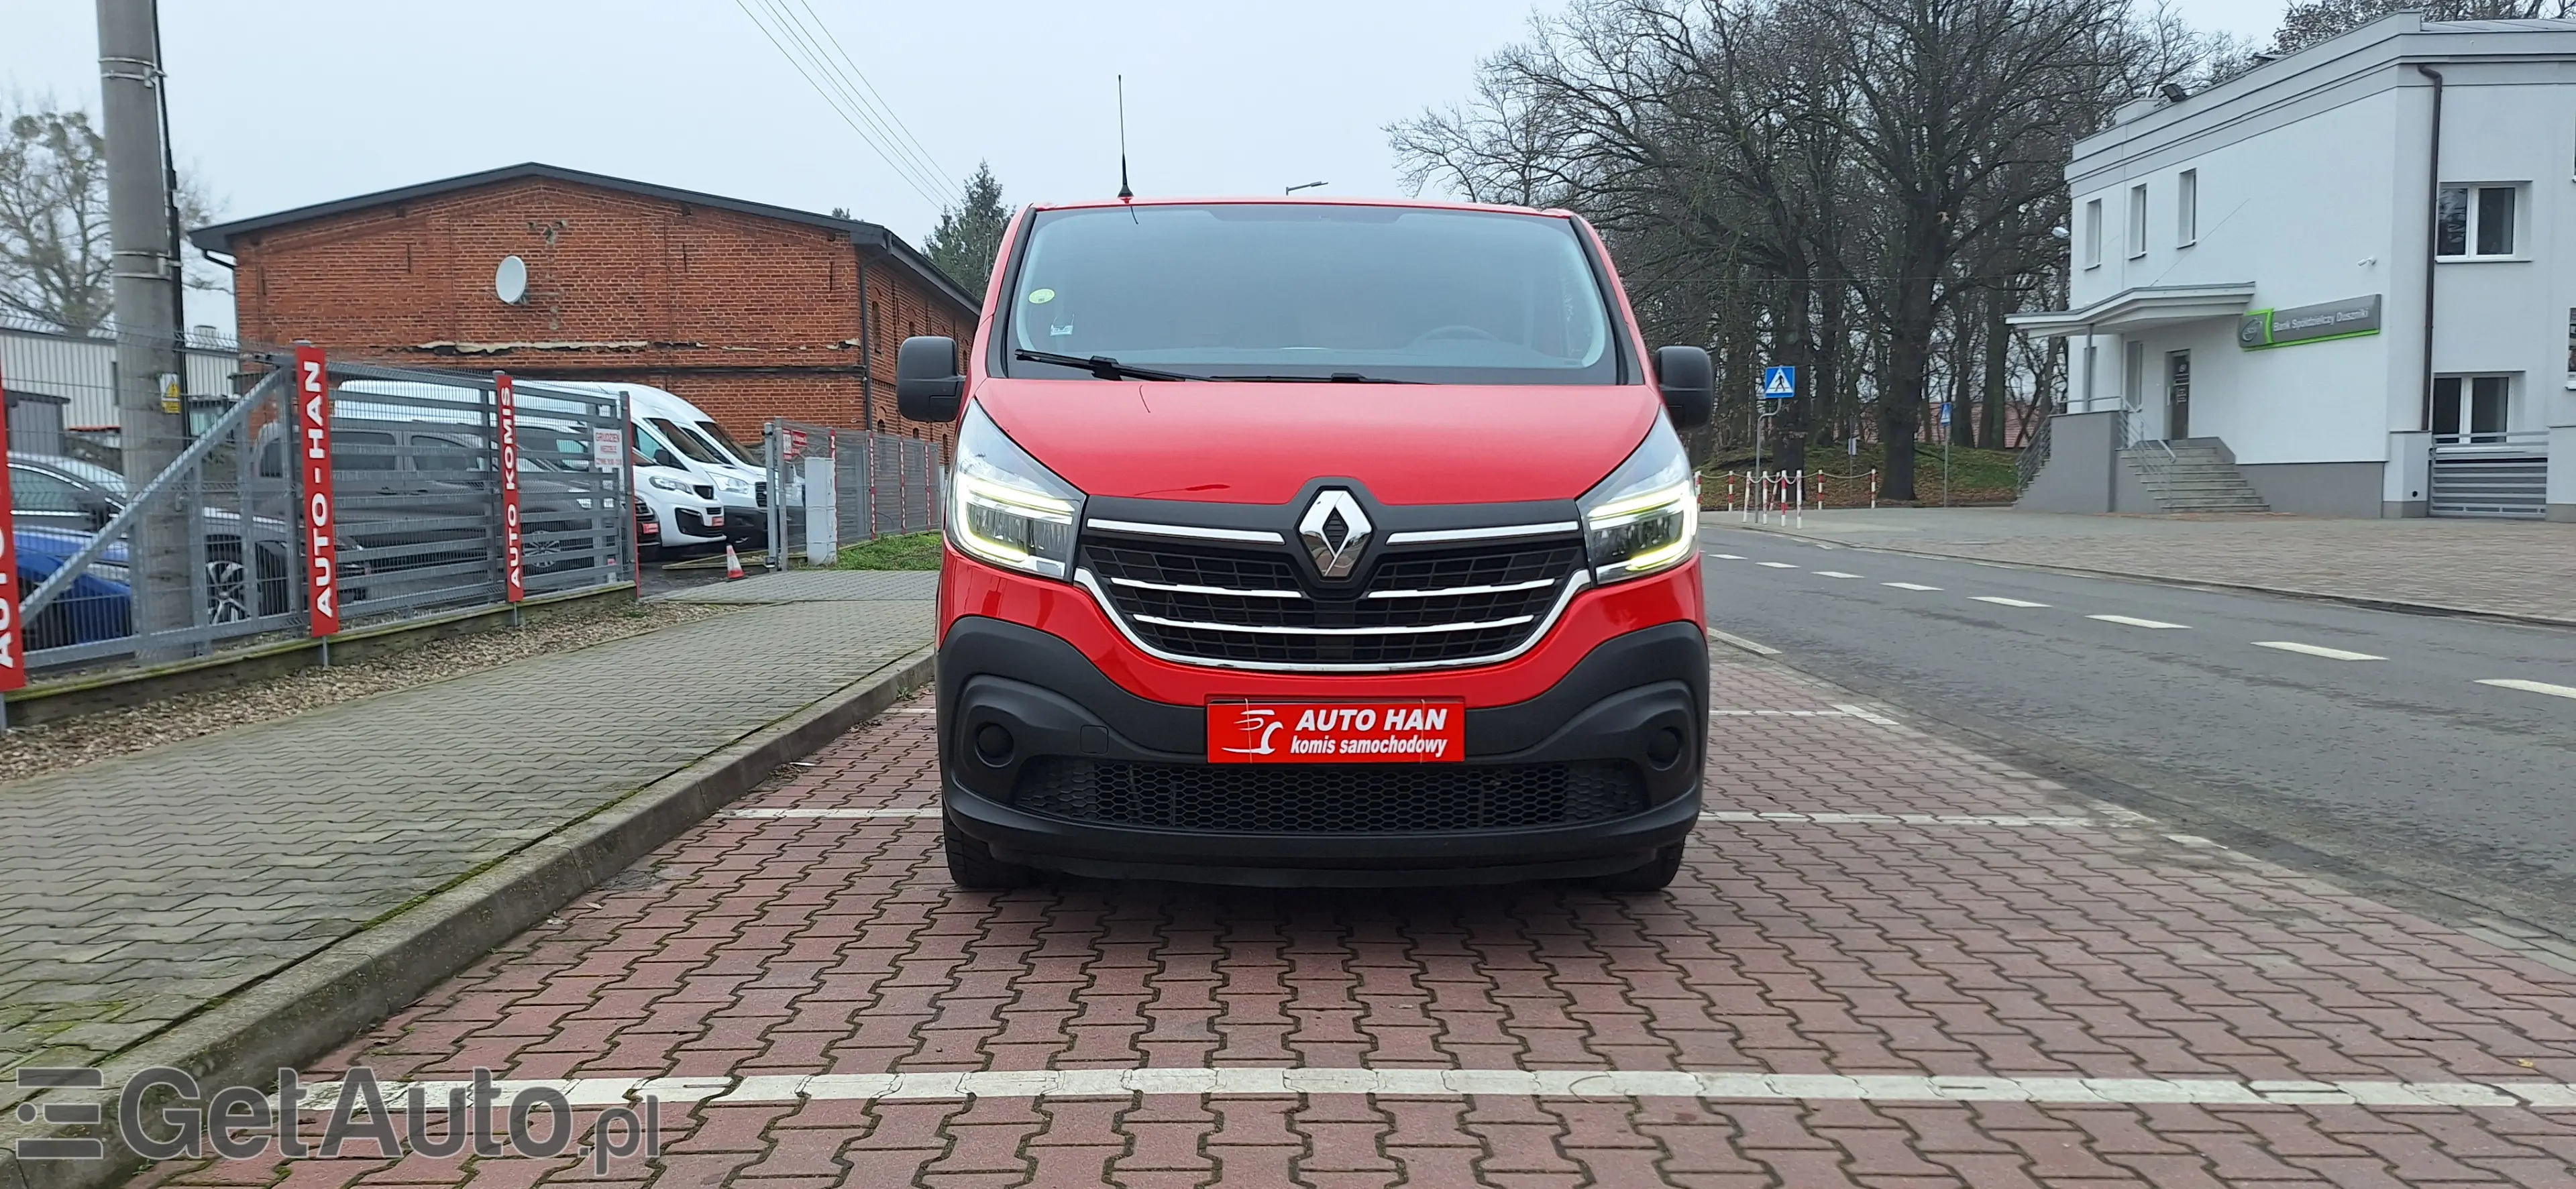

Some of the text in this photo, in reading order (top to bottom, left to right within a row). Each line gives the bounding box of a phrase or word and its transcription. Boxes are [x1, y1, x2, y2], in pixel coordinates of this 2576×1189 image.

[2273, 321, 2290, 332] Bank
[303, 361, 325, 459] HAN
[501, 387, 521, 588] AUTO KOMIS
[312, 493, 333, 618] AUTO
[1290, 734, 1448, 758] komis samochodowy
[1295, 708, 1448, 732] AUTO HAN
